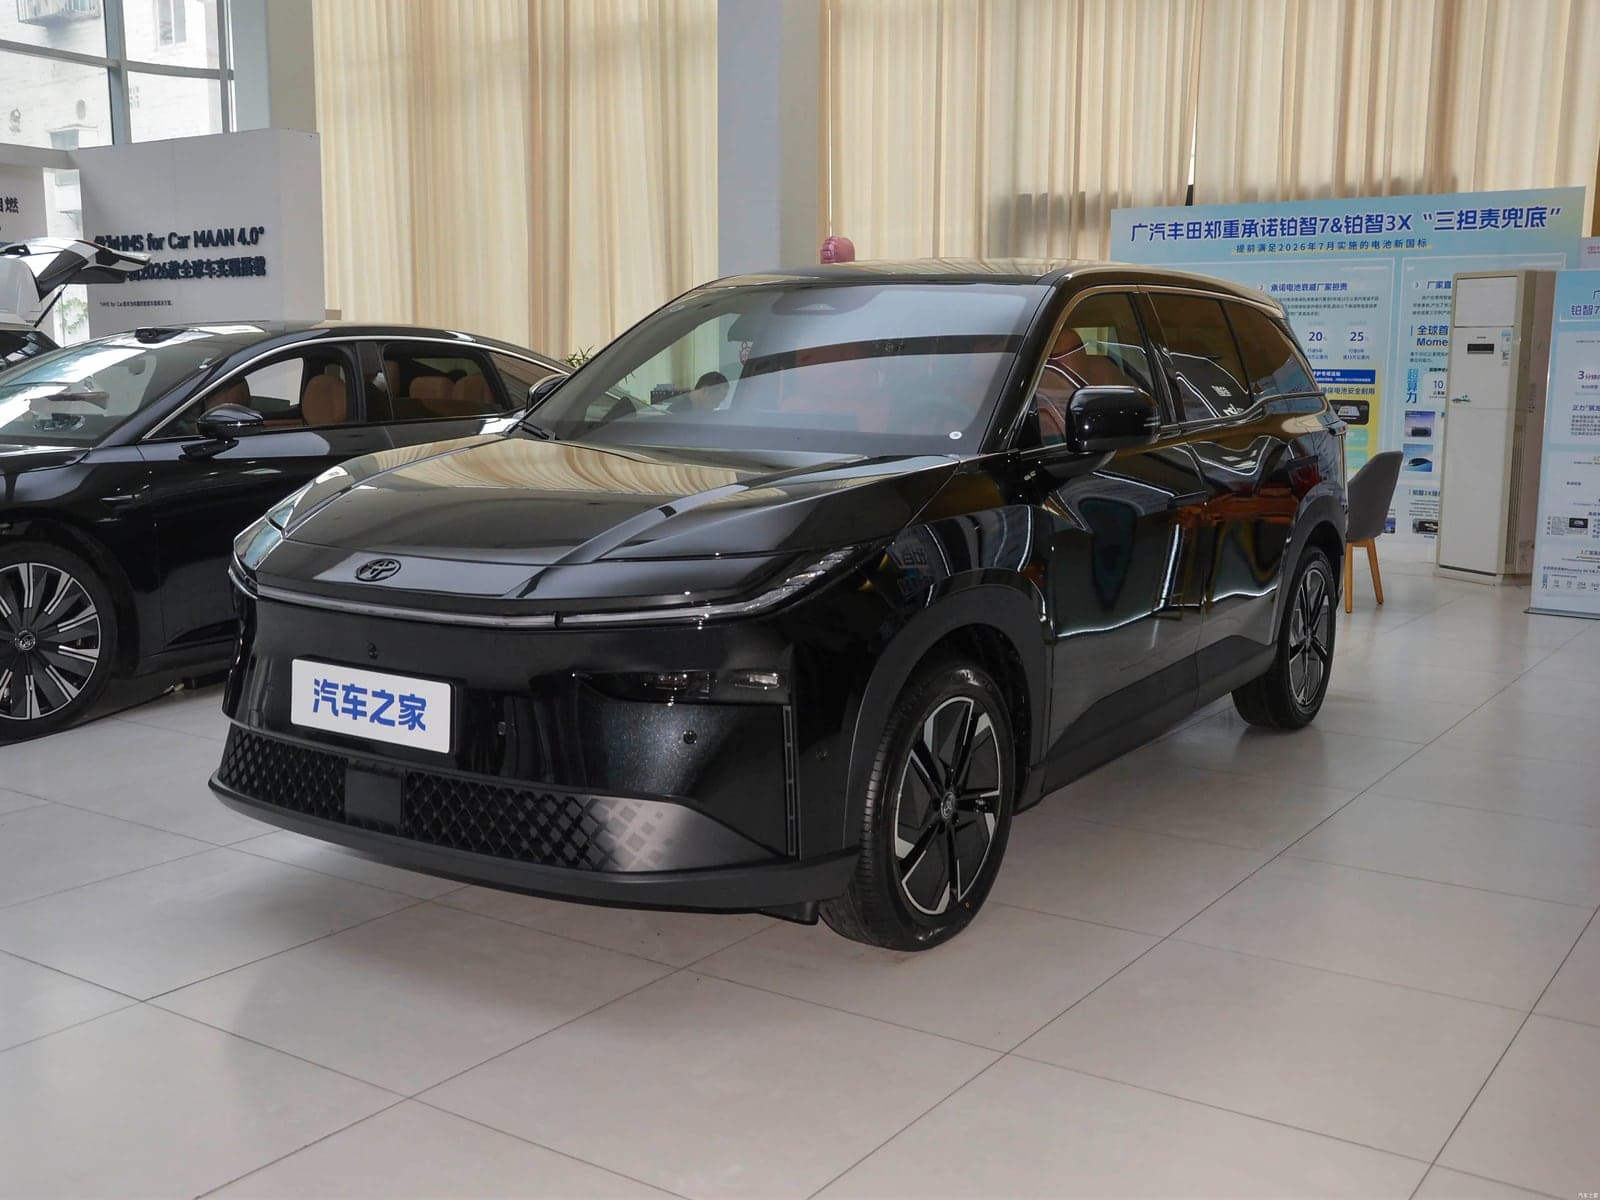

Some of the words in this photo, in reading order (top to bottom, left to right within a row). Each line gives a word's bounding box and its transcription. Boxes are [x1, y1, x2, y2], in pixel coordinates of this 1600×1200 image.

[146, 231, 166, 251] for
[167, 231, 191, 250] Car
[193, 228, 235, 248] MAAN
[312, 678, 427, 731] 汽车之家
